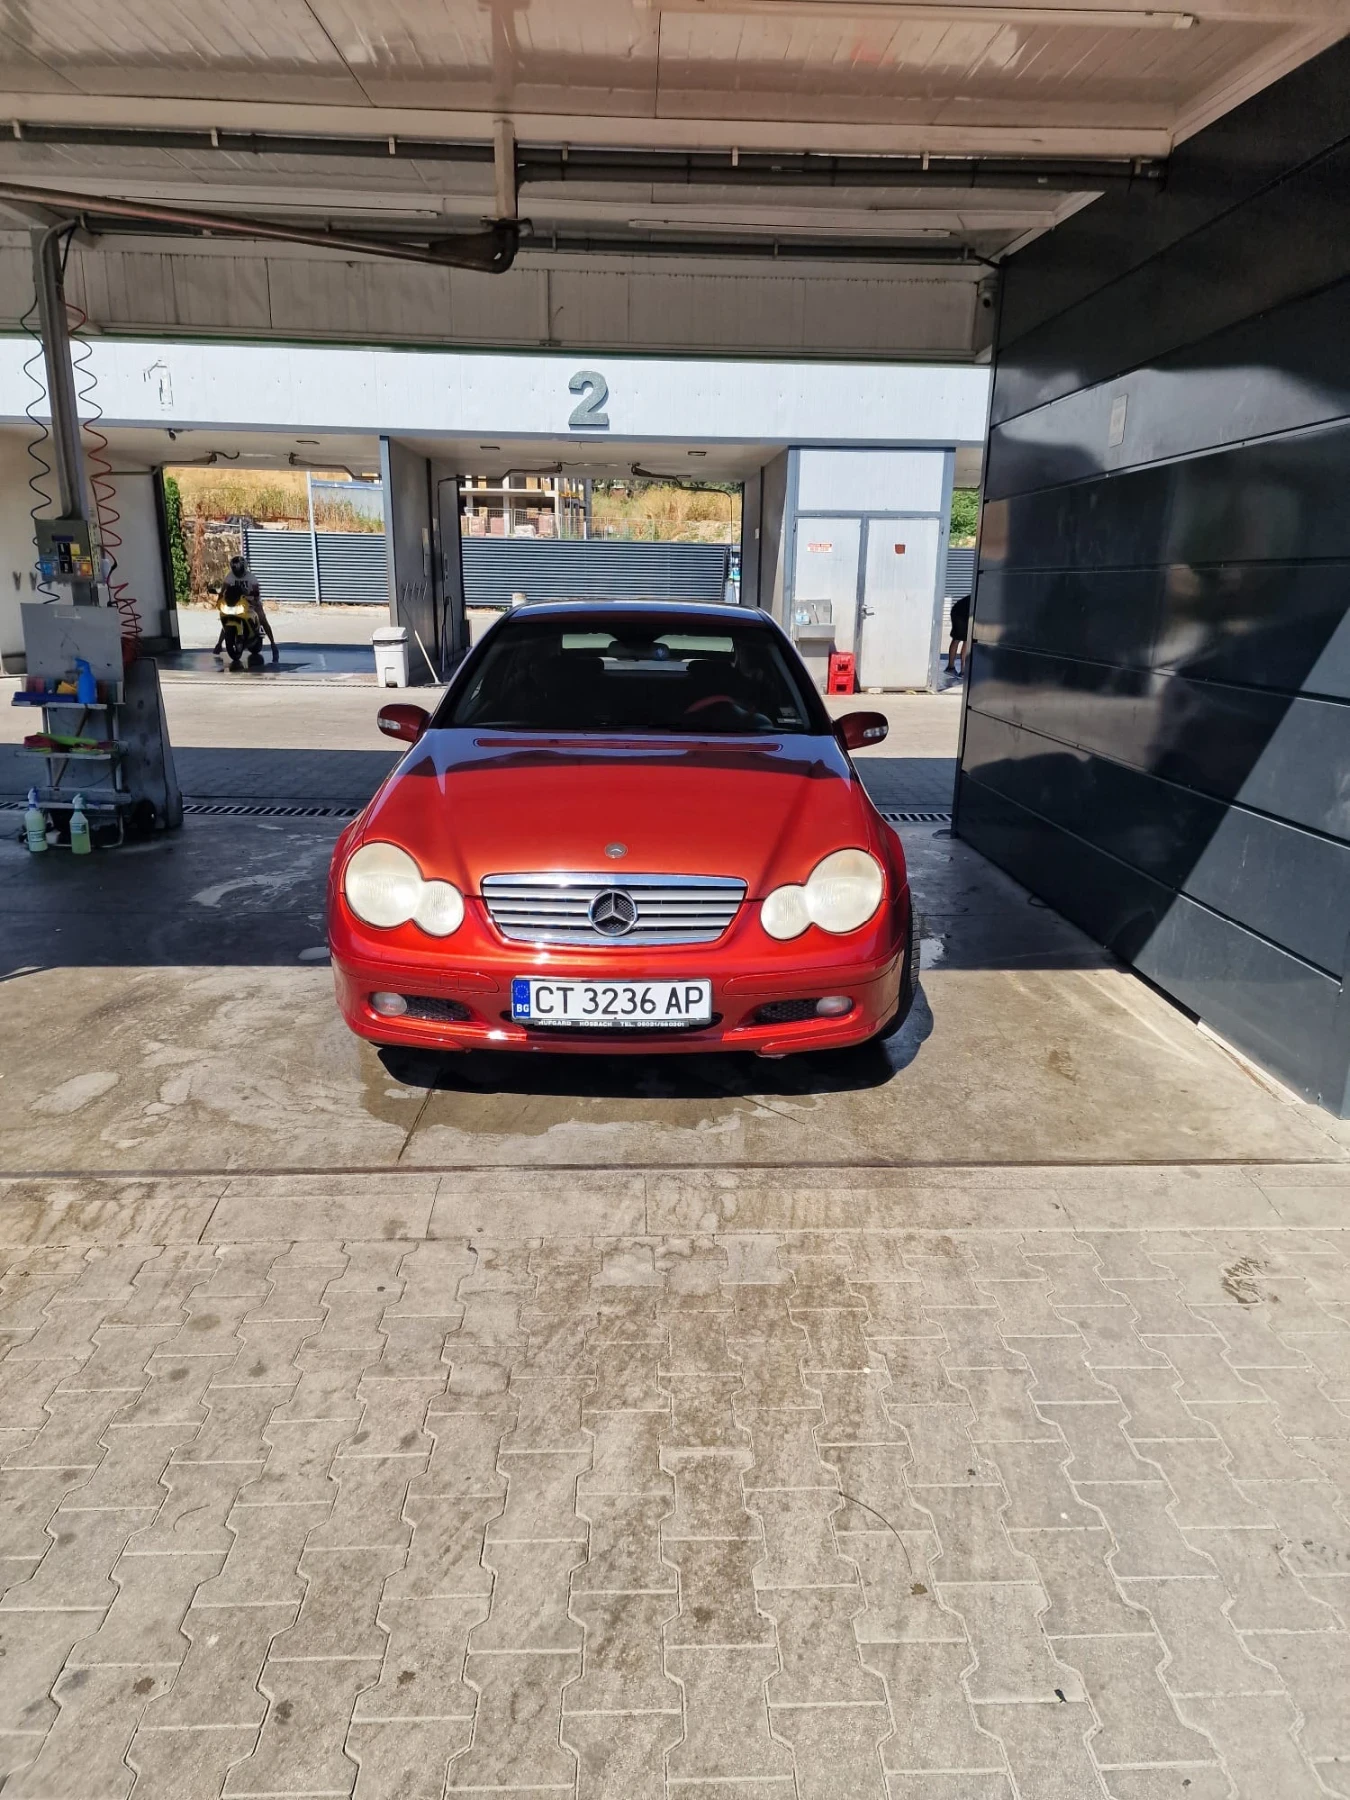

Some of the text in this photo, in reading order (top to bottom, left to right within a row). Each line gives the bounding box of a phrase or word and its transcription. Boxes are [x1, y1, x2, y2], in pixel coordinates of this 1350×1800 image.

[568, 370, 610, 426] 2
[516, 1003, 530, 1012] BG
[535, 986, 703, 1015] CT 3236 AP
